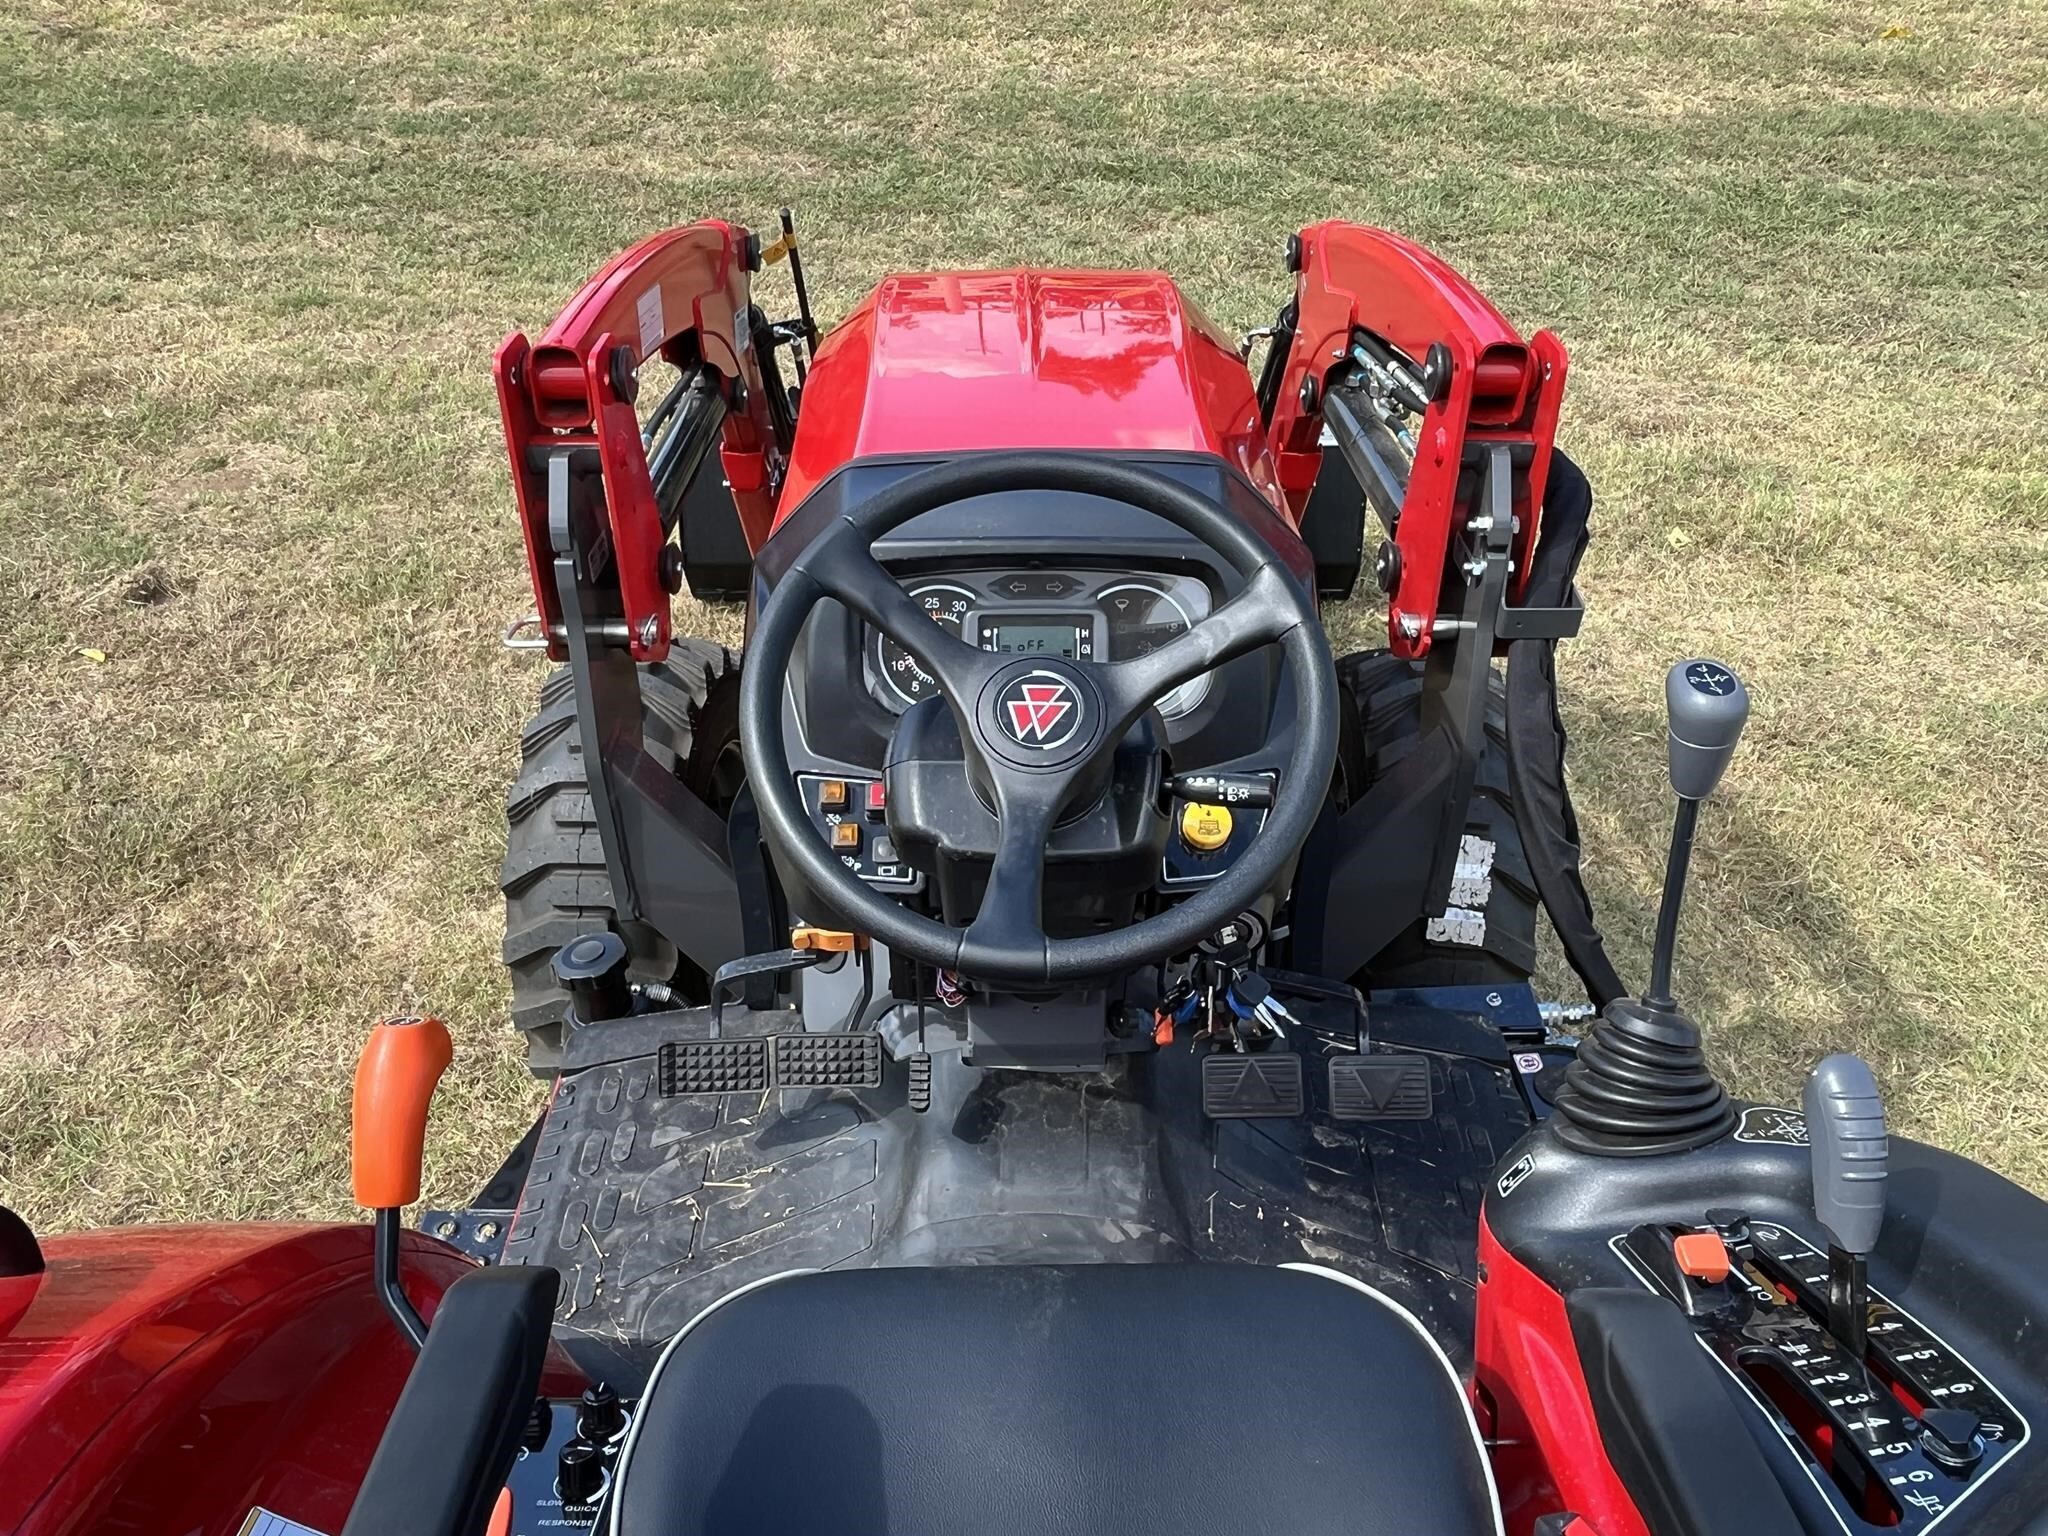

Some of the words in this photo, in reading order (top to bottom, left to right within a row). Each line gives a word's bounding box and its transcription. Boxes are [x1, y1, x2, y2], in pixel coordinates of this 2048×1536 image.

[924, 597, 940, 609] 25
[952, 601, 967, 612] 30
[891, 660, 906, 672] 10
[911, 681, 920, 692] 5
[1881, 1322, 1904, 1331] 4
[1809, 1355, 1832, 1364] 1
[1913, 1349, 1939, 1361] 5
[1824, 1372, 1850, 1384] 2
[1950, 1383, 1975, 1394] 6
[1845, 1393, 1869, 1405] 3
[1865, 1417, 1891, 1428] 4
[1886, 1441, 1913, 1454] 5
[1908, 1470, 1934, 1483] 6
